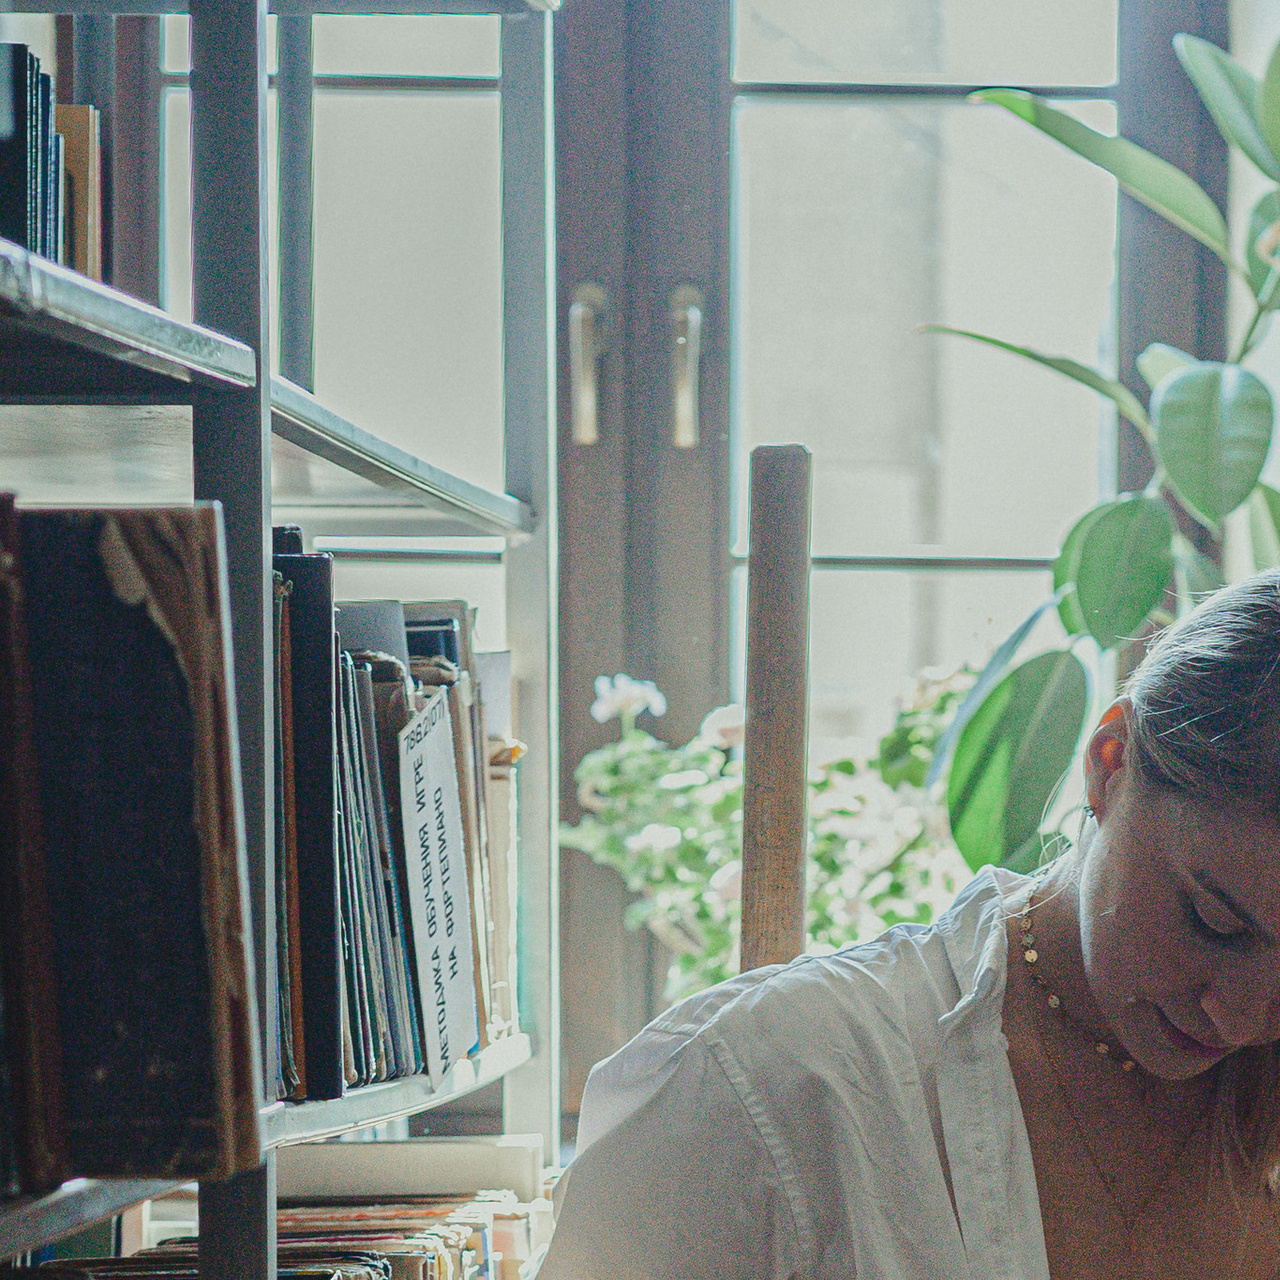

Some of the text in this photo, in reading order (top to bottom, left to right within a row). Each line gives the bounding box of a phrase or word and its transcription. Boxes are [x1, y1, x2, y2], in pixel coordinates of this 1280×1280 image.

[411, 753, 451, 1076] МЕТОДИКА ОБУЧЕНИЯ ИГРЕ
[432, 783, 458, 980] НА ФОРТЕПИАНО
